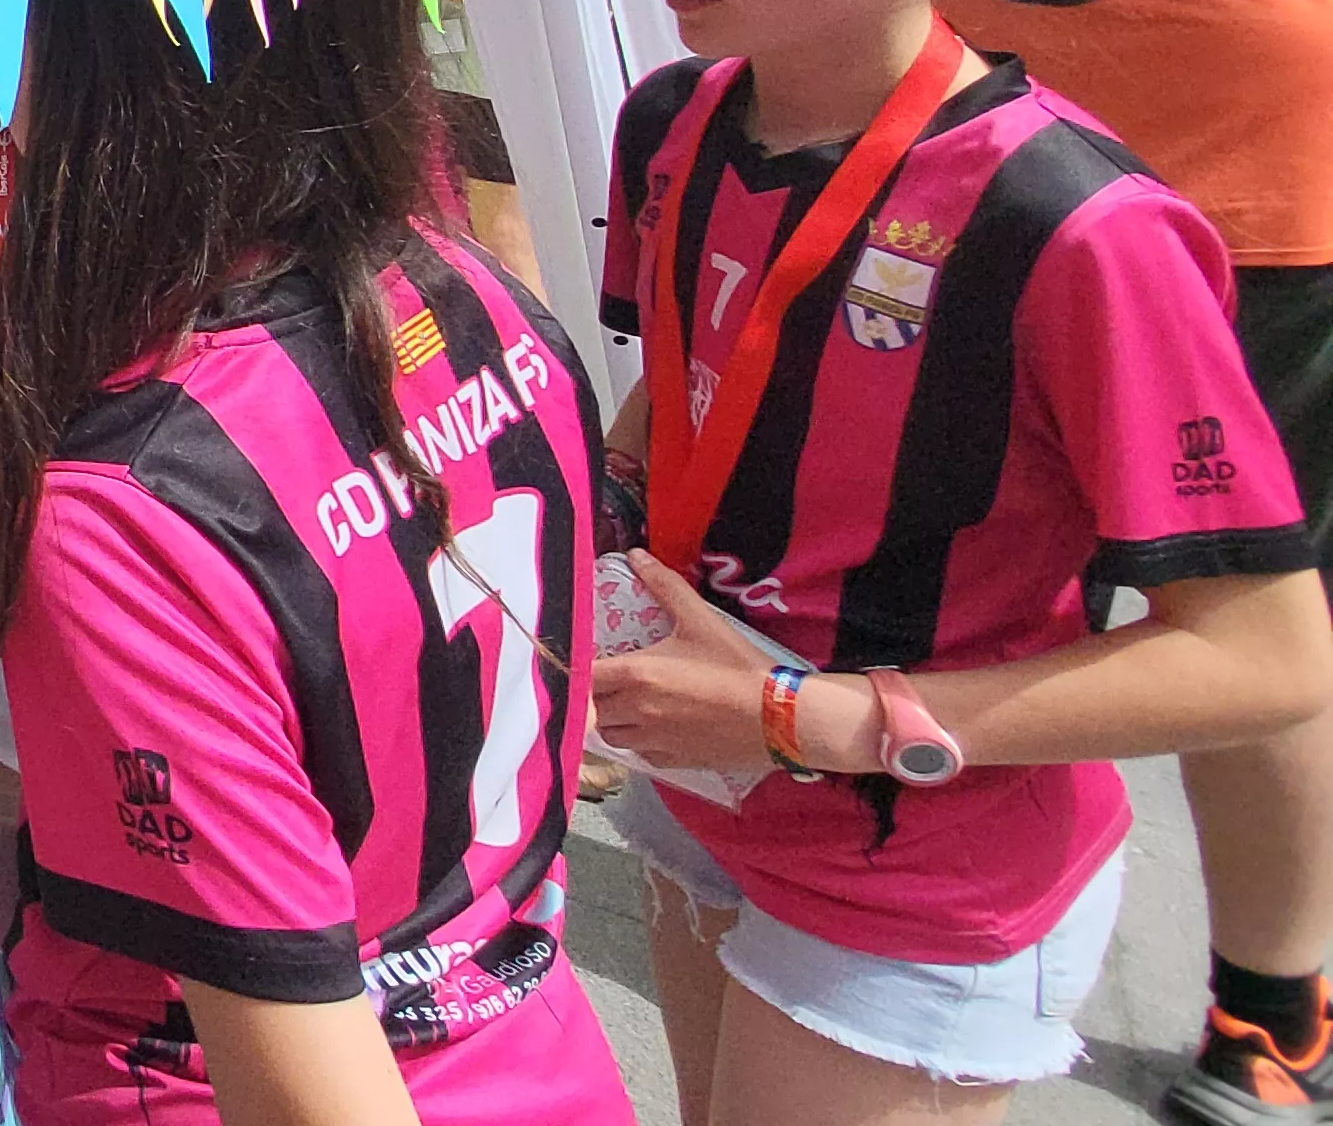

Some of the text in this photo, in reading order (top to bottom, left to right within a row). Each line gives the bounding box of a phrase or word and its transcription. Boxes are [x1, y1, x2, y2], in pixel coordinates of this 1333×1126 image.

[710, 252, 747, 331] 7
[1172, 461, 1236, 482] DAD
[317, 471, 386, 557] CD
[428, 487, 544, 848] 7
[117, 801, 193, 843] DAD
[460, 942, 551, 994] Gaudioso
[420, 1002, 463, 1022] 325
